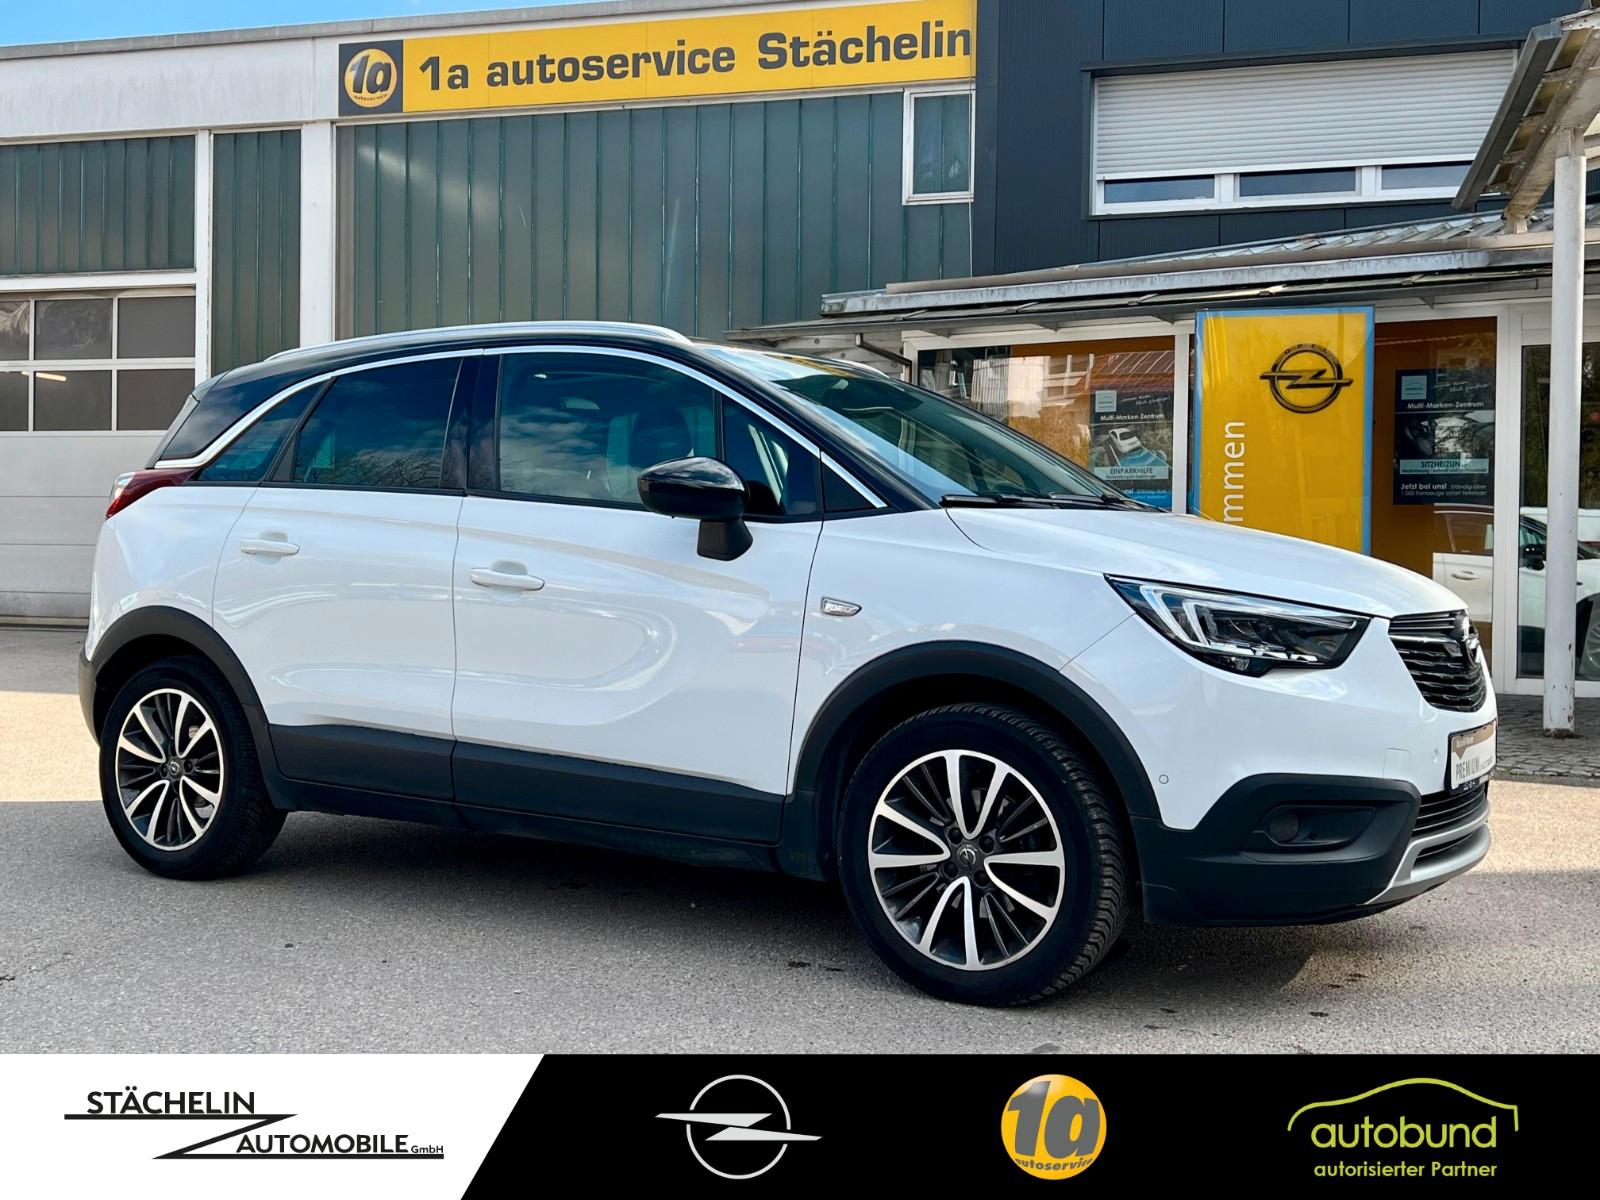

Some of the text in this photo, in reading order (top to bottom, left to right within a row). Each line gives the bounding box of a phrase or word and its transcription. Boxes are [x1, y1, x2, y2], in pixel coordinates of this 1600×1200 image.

[350, 54, 392, 94] 1a
[419, 20, 971, 91] 1a autoservice Stächelin
[1223, 420, 1246, 523] mmen
